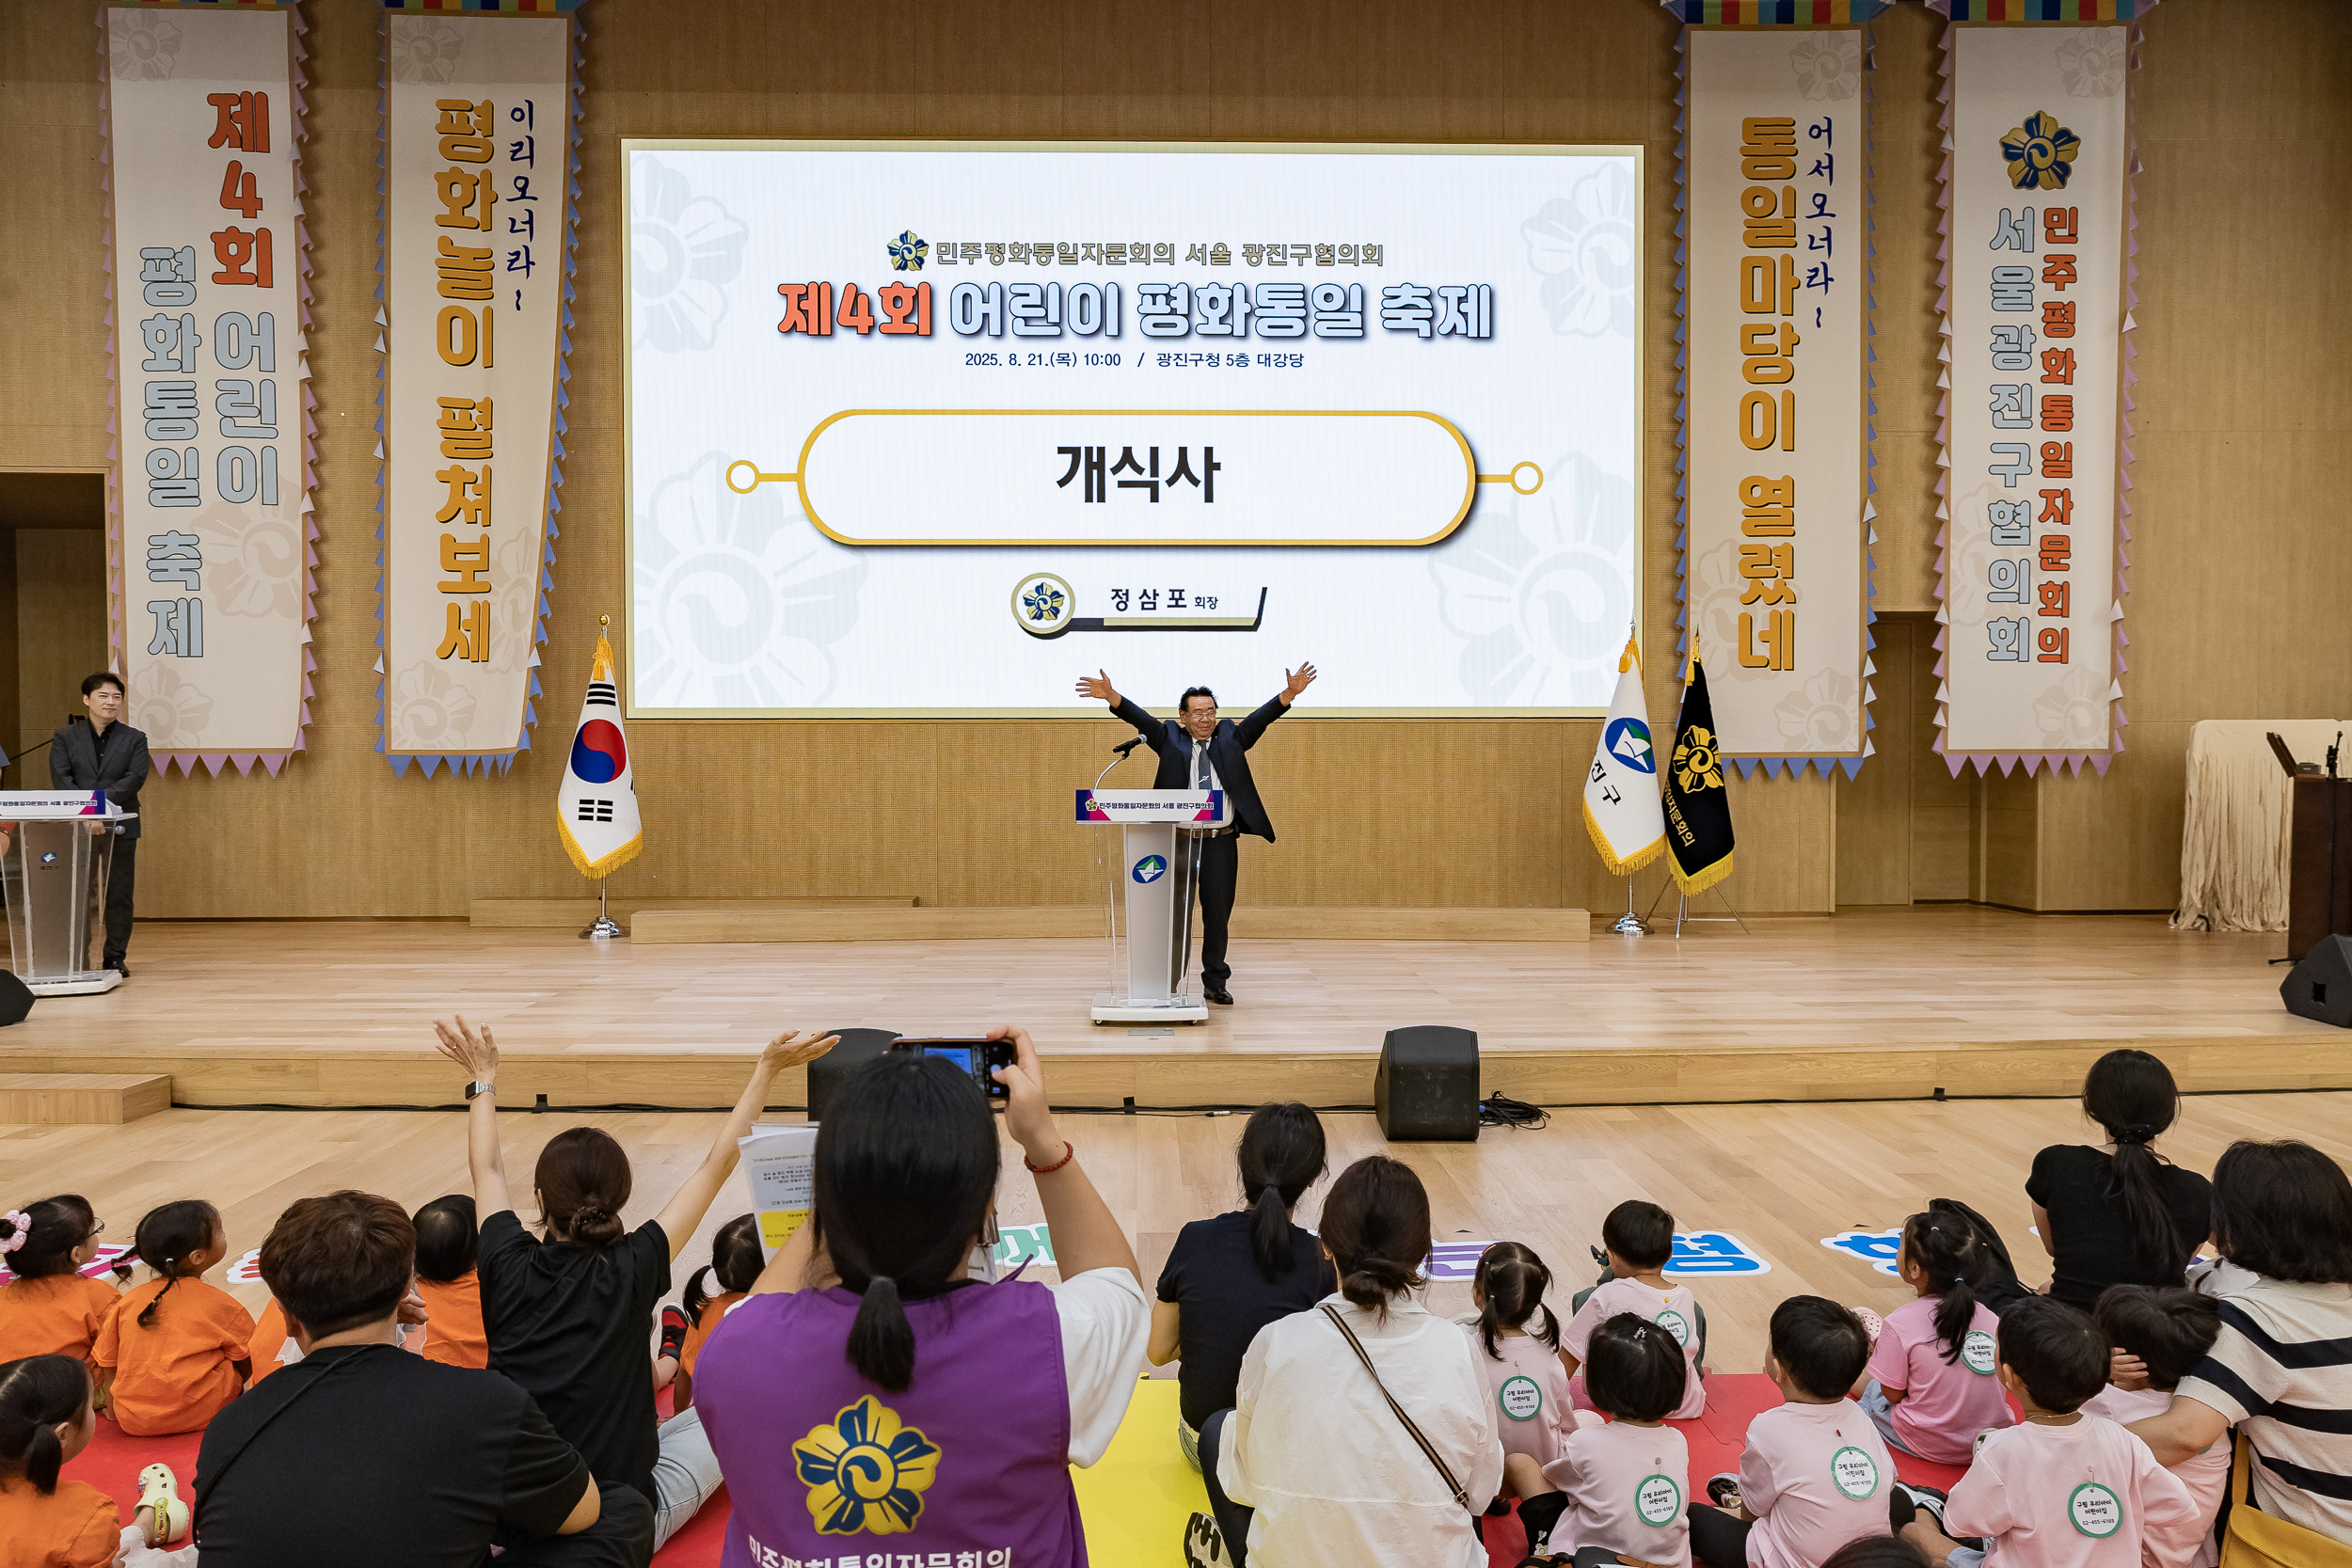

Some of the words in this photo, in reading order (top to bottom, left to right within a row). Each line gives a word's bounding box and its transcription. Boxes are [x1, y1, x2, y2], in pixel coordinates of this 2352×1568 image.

[207, 91, 273, 289] 제4회
[434, 98, 498, 370] 평화놀이
[936, 241, 1175, 267] 민주평화통일자문회의
[1185, 242, 1232, 266] 서울
[1242, 243, 1385, 268] 광진구협의회
[1739, 116, 1801, 452] 통일마당이
[139, 245, 203, 508] 평화통일
[215, 311, 279, 506] 어린이
[776, 281, 933, 338] 제4회
[950, 282, 1121, 338] 어린이
[1136, 282, 1365, 339] 평화통일
[1380, 282, 1493, 340] 축제
[964, 353, 1003, 367] 2025.
[1009, 353, 1022, 367] 8.
[1083, 353, 1121, 367] 10:00
[1155, 352, 1220, 368] 광진구청
[1226, 352, 1251, 368] 5층
[1257, 353, 1305, 368] 대강당
[435, 395, 495, 664] 펼쳐보세
[1056, 445, 1222, 504] 개식사
[2037, 205, 2079, 665] 민주평화통일자문회의
[147, 530, 204, 658] 축제
[1194, 595, 1219, 610] 회장
[1738, 474, 1797, 673] 열렸네
